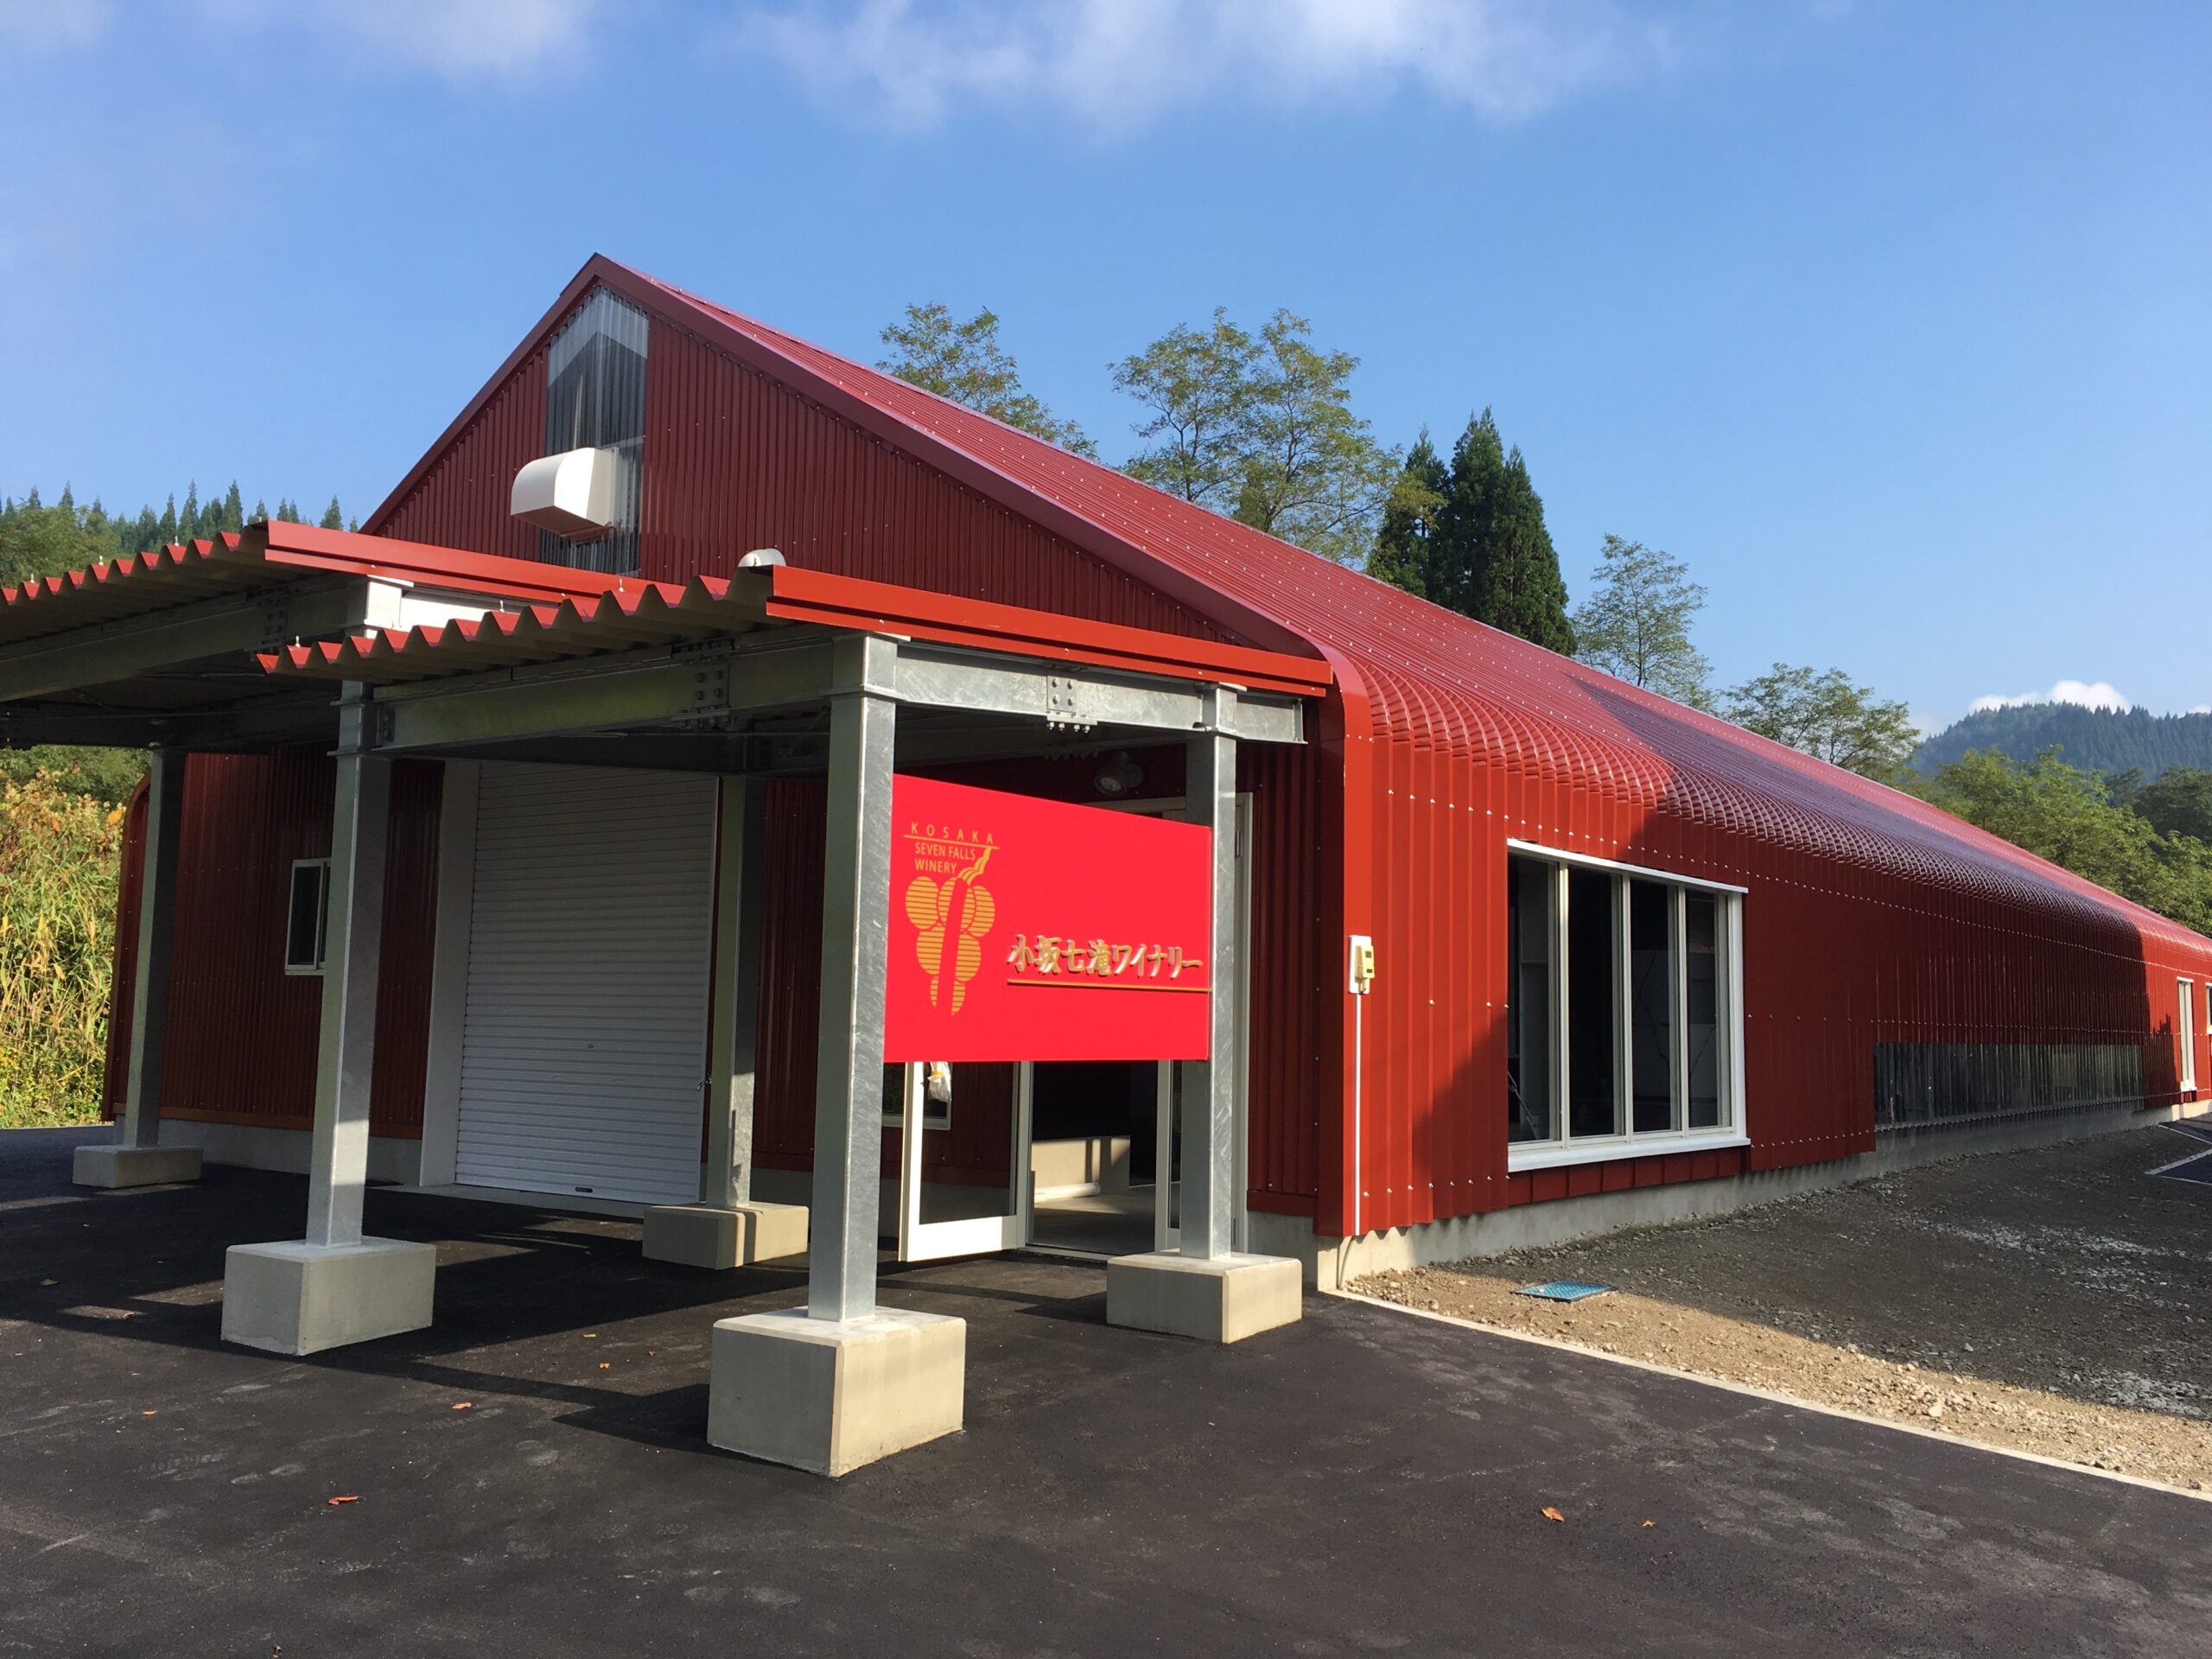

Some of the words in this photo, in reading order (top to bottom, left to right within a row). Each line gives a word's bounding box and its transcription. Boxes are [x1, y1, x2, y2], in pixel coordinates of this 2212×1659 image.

[911, 822, 993, 844] KOSAKA
[914, 842, 946, 857] SEVEN
[948, 845, 976, 861] FALLS
[914, 857, 957, 874] WINERY
[1006, 934, 1204, 980] 小坂七滝ワイナリー
